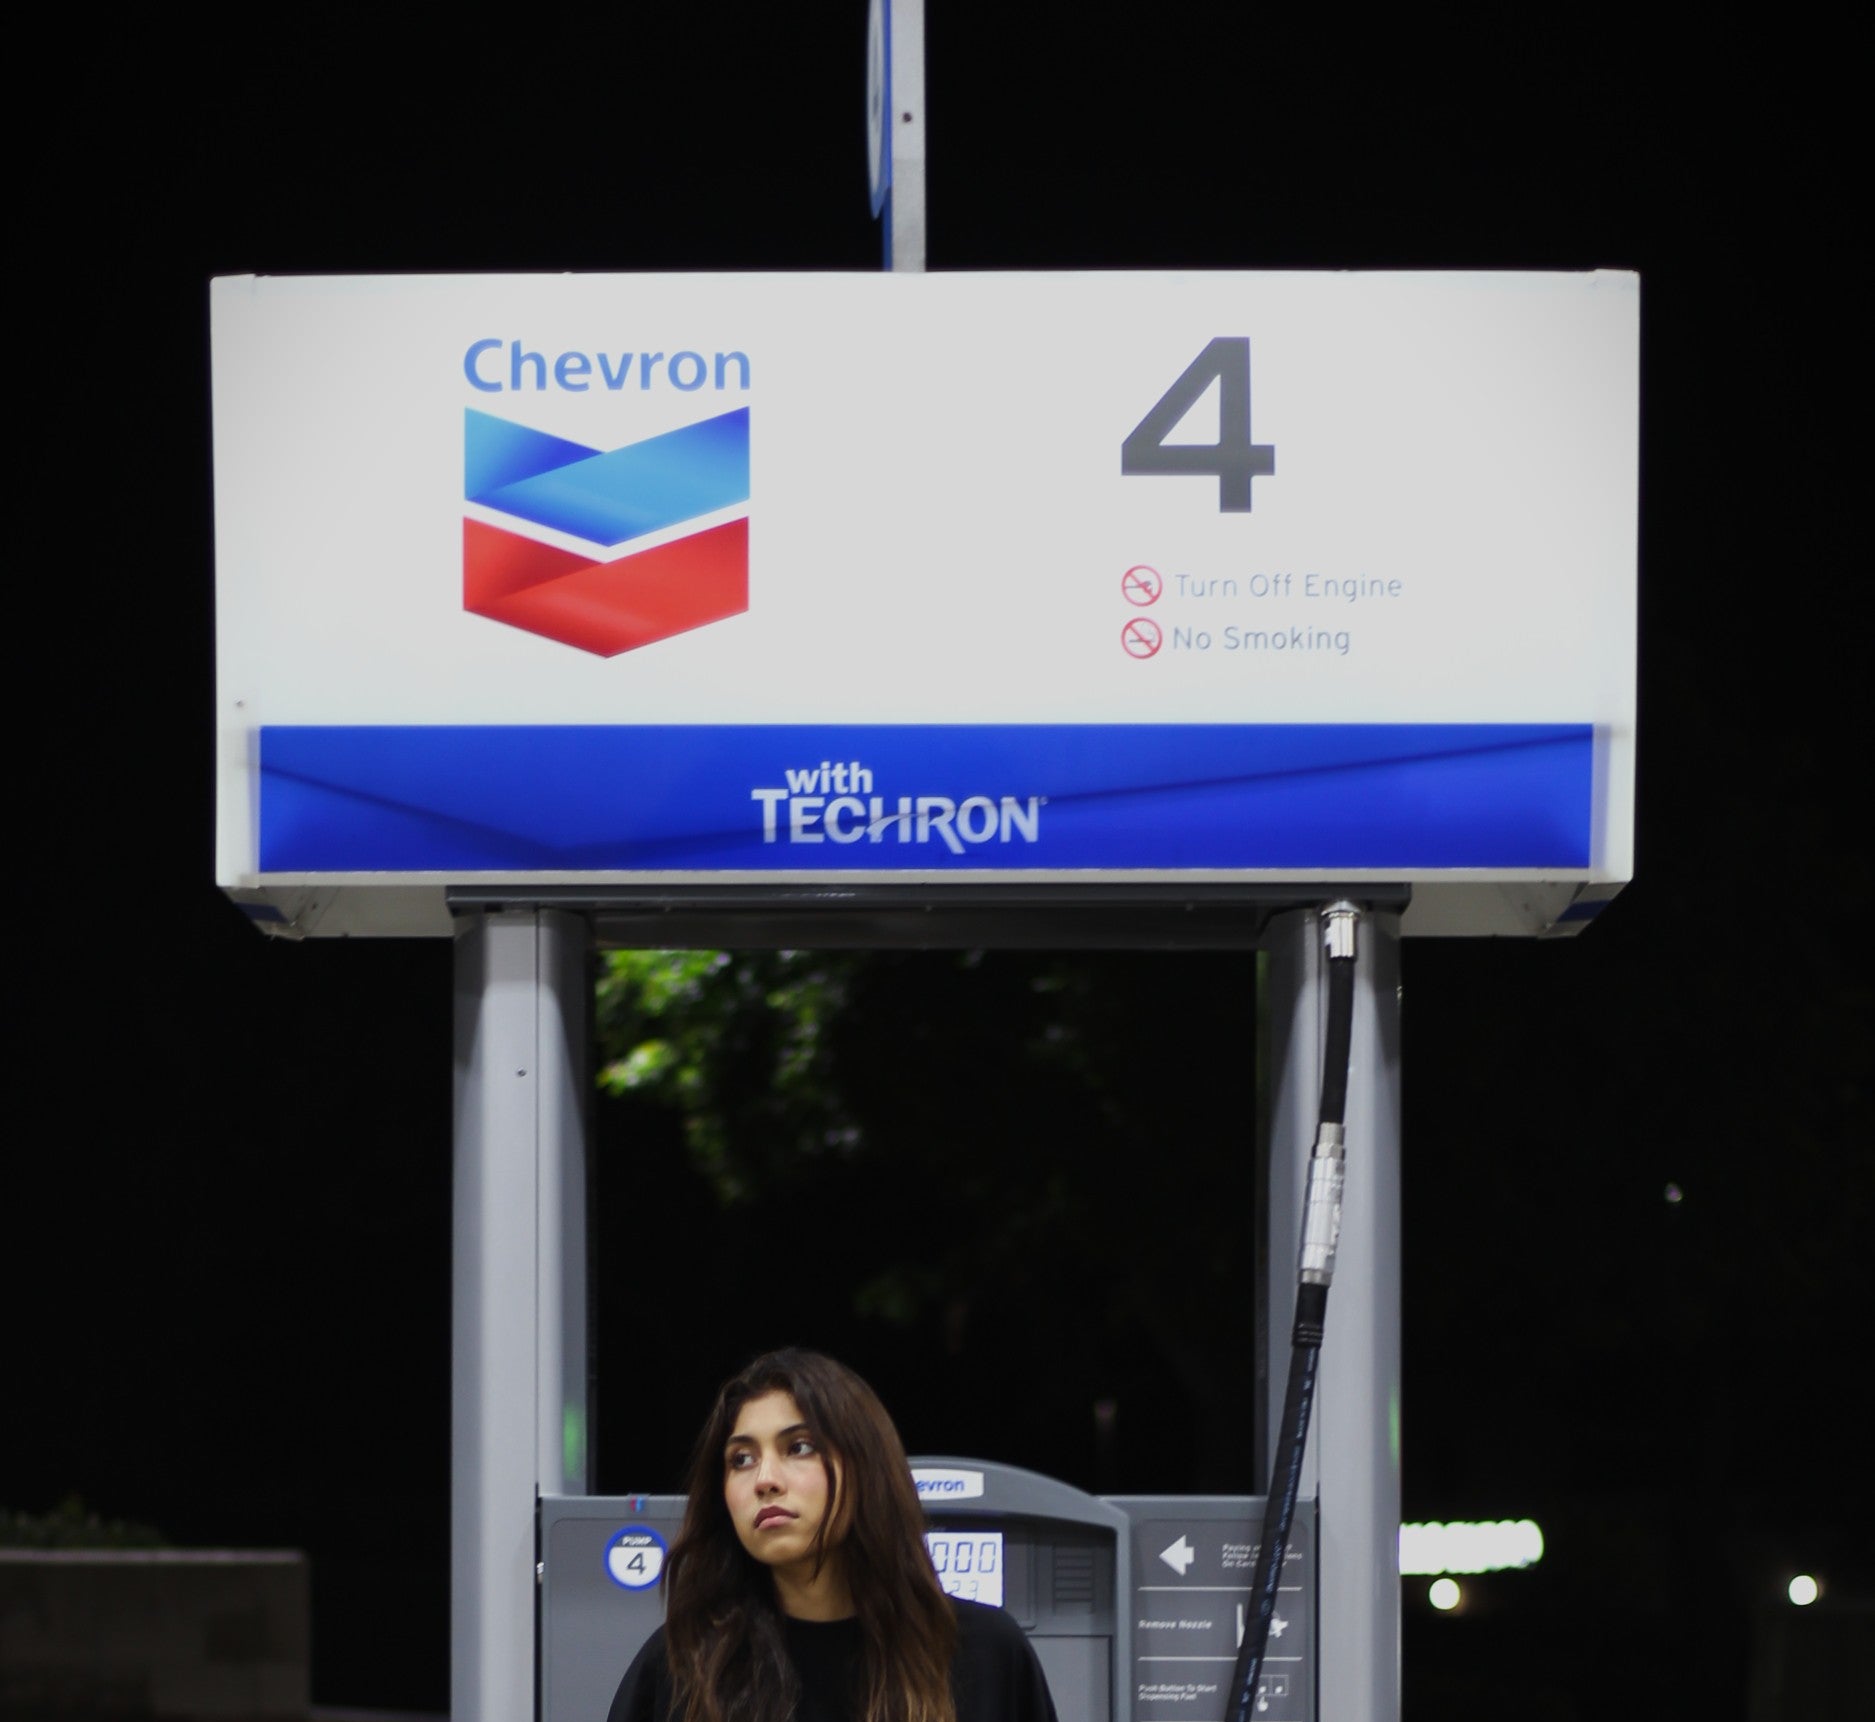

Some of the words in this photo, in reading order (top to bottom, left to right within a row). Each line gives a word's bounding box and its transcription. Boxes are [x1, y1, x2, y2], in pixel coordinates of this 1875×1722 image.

[463, 338, 751, 393] Chevron
[1121, 336, 1275, 513] 4
[1175, 573, 1237, 597] Turn
[1250, 573, 1293, 598] Off
[1304, 573, 1402, 602] Engine
[1173, 626, 1212, 650] No
[1224, 625, 1350, 655] Smoking
[785, 760, 873, 795] with
[751, 788, 1039, 854] TECHRON
[916, 1479, 964, 1492] evron
[626, 1552, 647, 1575] 4
[1138, 1619, 1177, 1630] Remove
[1179, 1619, 1212, 1630] Nozzle
